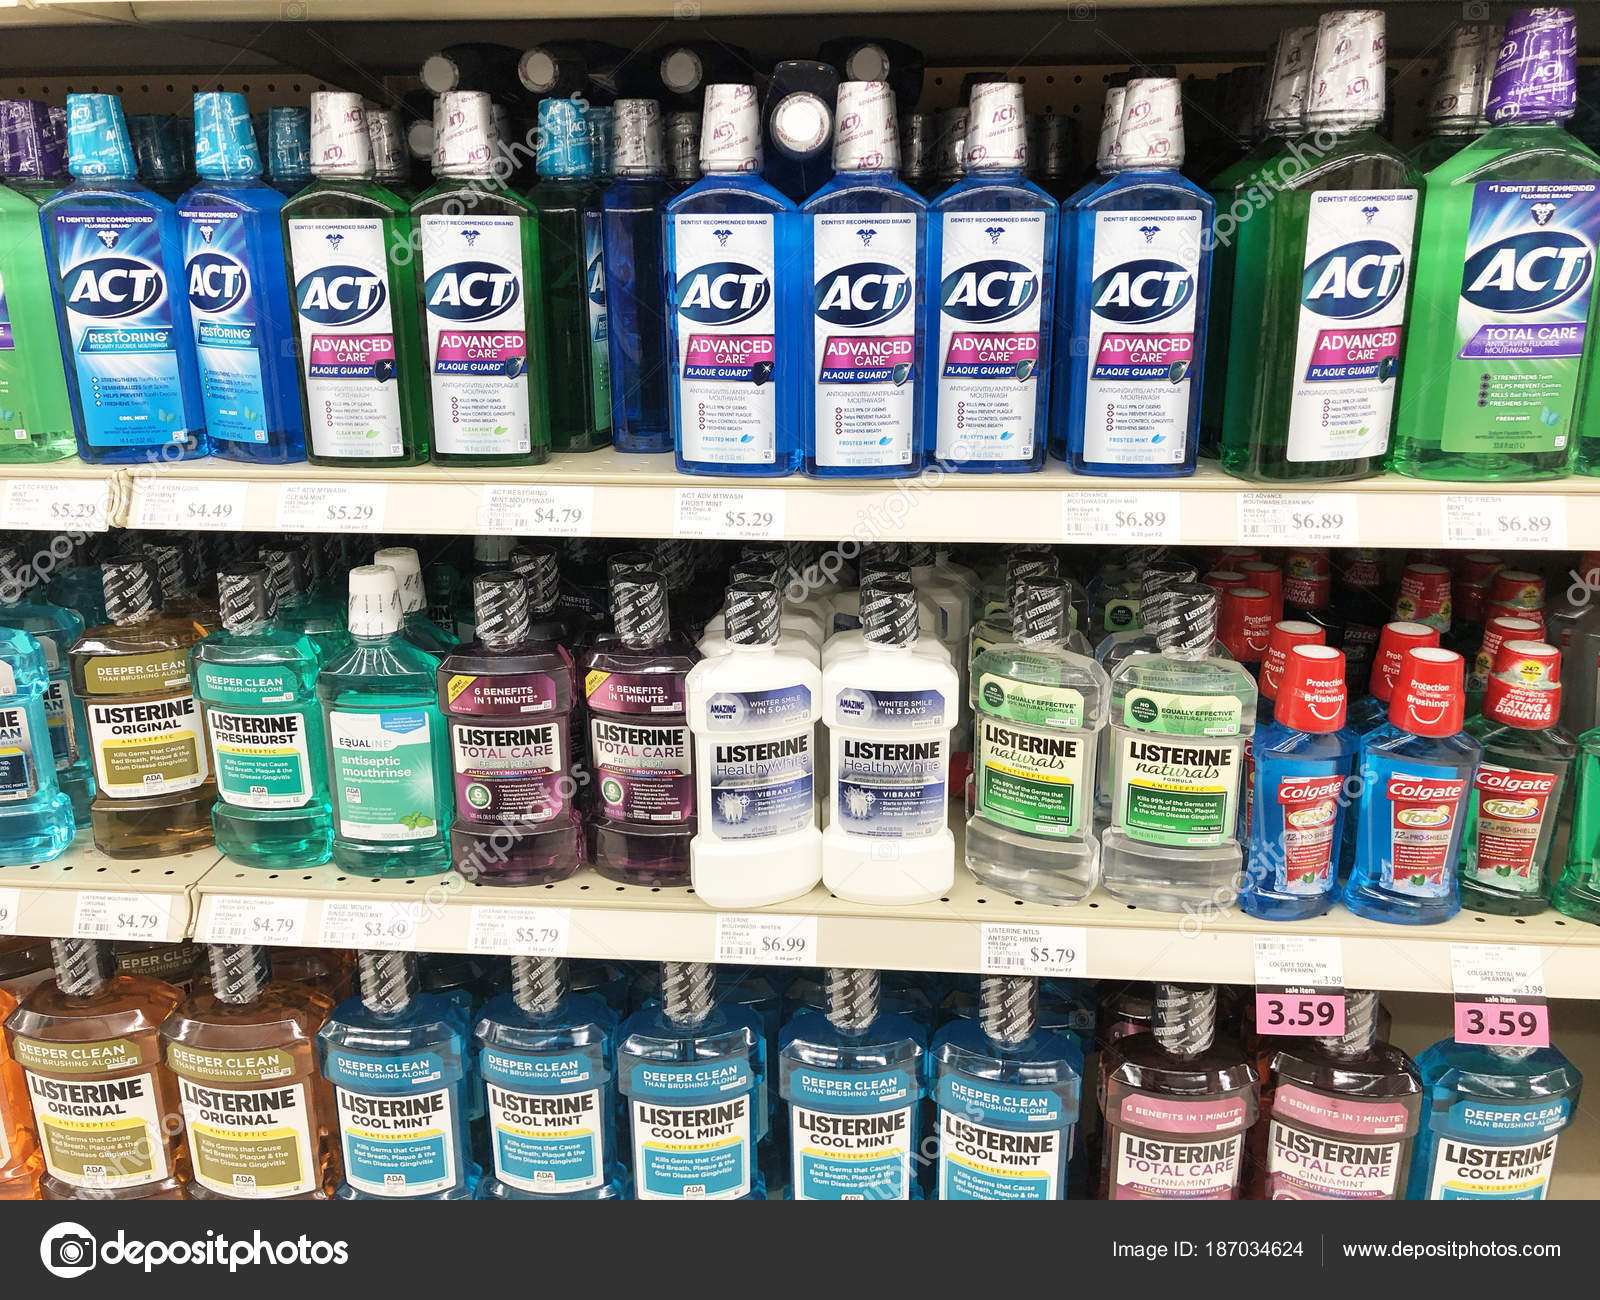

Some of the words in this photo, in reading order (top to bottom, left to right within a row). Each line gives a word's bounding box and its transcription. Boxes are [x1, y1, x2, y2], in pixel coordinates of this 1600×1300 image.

[1306, 254, 1404, 300] ACT
[1467, 246, 1591, 292] ACT
[69, 269, 156, 302] ACT
[189, 265, 243, 298] ACT
[944, 272, 1035, 307] ACT
[1095, 272, 1192, 307] ACT
[301, 277, 381, 310] ACT
[429, 273, 516, 307] ACT
[680, 274, 767, 309] ACT
[819, 276, 910, 311] ACT
[441, 335, 524, 348] ADVANCED
[1320, 332, 1396, 350] ADVANCED
[1486, 329, 1533, 340] TOTAL
[1537, 328, 1577, 339] CARE
[313, 339, 391, 352] ADVANCED
[690, 340, 772, 353] ADVANCED
[827, 341, 911, 355] ADVANCED
[952, 338, 1035, 351] ADVANCED
[1102, 338, 1191, 351] ADVANCED
[438, 363, 469, 371] PLAQUE
[687, 367, 717, 376] PLAQUE
[1312, 368, 1346, 376] PLAQUE
[51, 504, 95, 518] $5.29
[187, 503, 232, 518] $4.49
[327, 505, 373, 520] $5.29
[535, 508, 581, 524] $4.79
[726, 512, 772, 527] $5.29
[1116, 511, 1165, 528] $6.89
[1292, 513, 1343, 530] $6.89
[1499, 516, 1551, 532] $6.89
[97, 666, 143, 675] DEEPER
[146, 660, 185, 672] CLEAN
[483, 687, 533, 695] BENEFITS
[1411, 680, 1450, 691] Protection
[1407, 695, 1449, 707] Brushings
[1499, 698, 1542, 712] EATING
[1545, 704, 1551, 712] &
[95, 699, 194, 724] LISTERINE
[710, 705, 736, 714] AMAZING
[1496, 706, 1550, 720] DRINKING
[111, 720, 181, 735] ORIGINAL
[211, 713, 297, 733] LISTERINE
[216, 732, 295, 744] FRESHBURST
[458, 726, 552, 746] LISTERINE
[596, 724, 684, 746] LISTERINE
[986, 724, 1076, 758] LISTERINE
[461, 746, 505, 758] TOTAL
[511, 745, 553, 757] CARE
[717, 735, 808, 762] LISTERINE
[845, 740, 941, 760] LISTERINE
[1130, 742, 1231, 765] LISTERINE
[341, 756, 400, 766] antiseptic
[990, 746, 1064, 769] naturals
[343, 767, 411, 777] mouthrinse
[1136, 763, 1220, 779] naturals
[1476, 772, 1551, 791] Colgate
[757, 787, 792, 797] VIBRANT
[1280, 781, 1340, 800] Colgate
[1389, 783, 1462, 800] Colgate
[117, 915, 157, 929] $4.79
[253, 918, 293, 932] $4.79
[365, 923, 406, 936] $3.49
[516, 928, 558, 942] $5.79
[762, 937, 805, 952] $6.99
[1030, 947, 1075, 963] $5.79
[1324, 976, 1342, 984] 3.99
[1268, 1000, 1334, 1026] 3.59
[1466, 1009, 1537, 1036] 3.59
[173, 1048, 221, 1066] DEEPER
[224, 1055, 279, 1068] CLEAN
[338, 1058, 382, 1072] DEEPER
[386, 1060, 429, 1071] CLEAN
[30, 1076, 144, 1103] LISTERINE
[183, 1084, 295, 1112] LISTERINE
[341, 1092, 443, 1117] LISTERINE
[492, 1088, 593, 1114] LISTERINE
[48, 1102, 126, 1116] ORIGINAL
[640, 1100, 744, 1127] LISTERINE
[352, 1115, 391, 1129] COOL
[394, 1116, 432, 1129] MINT
[799, 1111, 906, 1136] LISTERINE
[945, 1116, 1053, 1153] LISTERINE
[1126, 1138, 1235, 1163] LISTERINE
[1275, 1126, 1393, 1165] LISTERINE
[1446, 1141, 1554, 1168] LISTERINE
[1150, 1177, 1212, 1186] CINNAMINT
